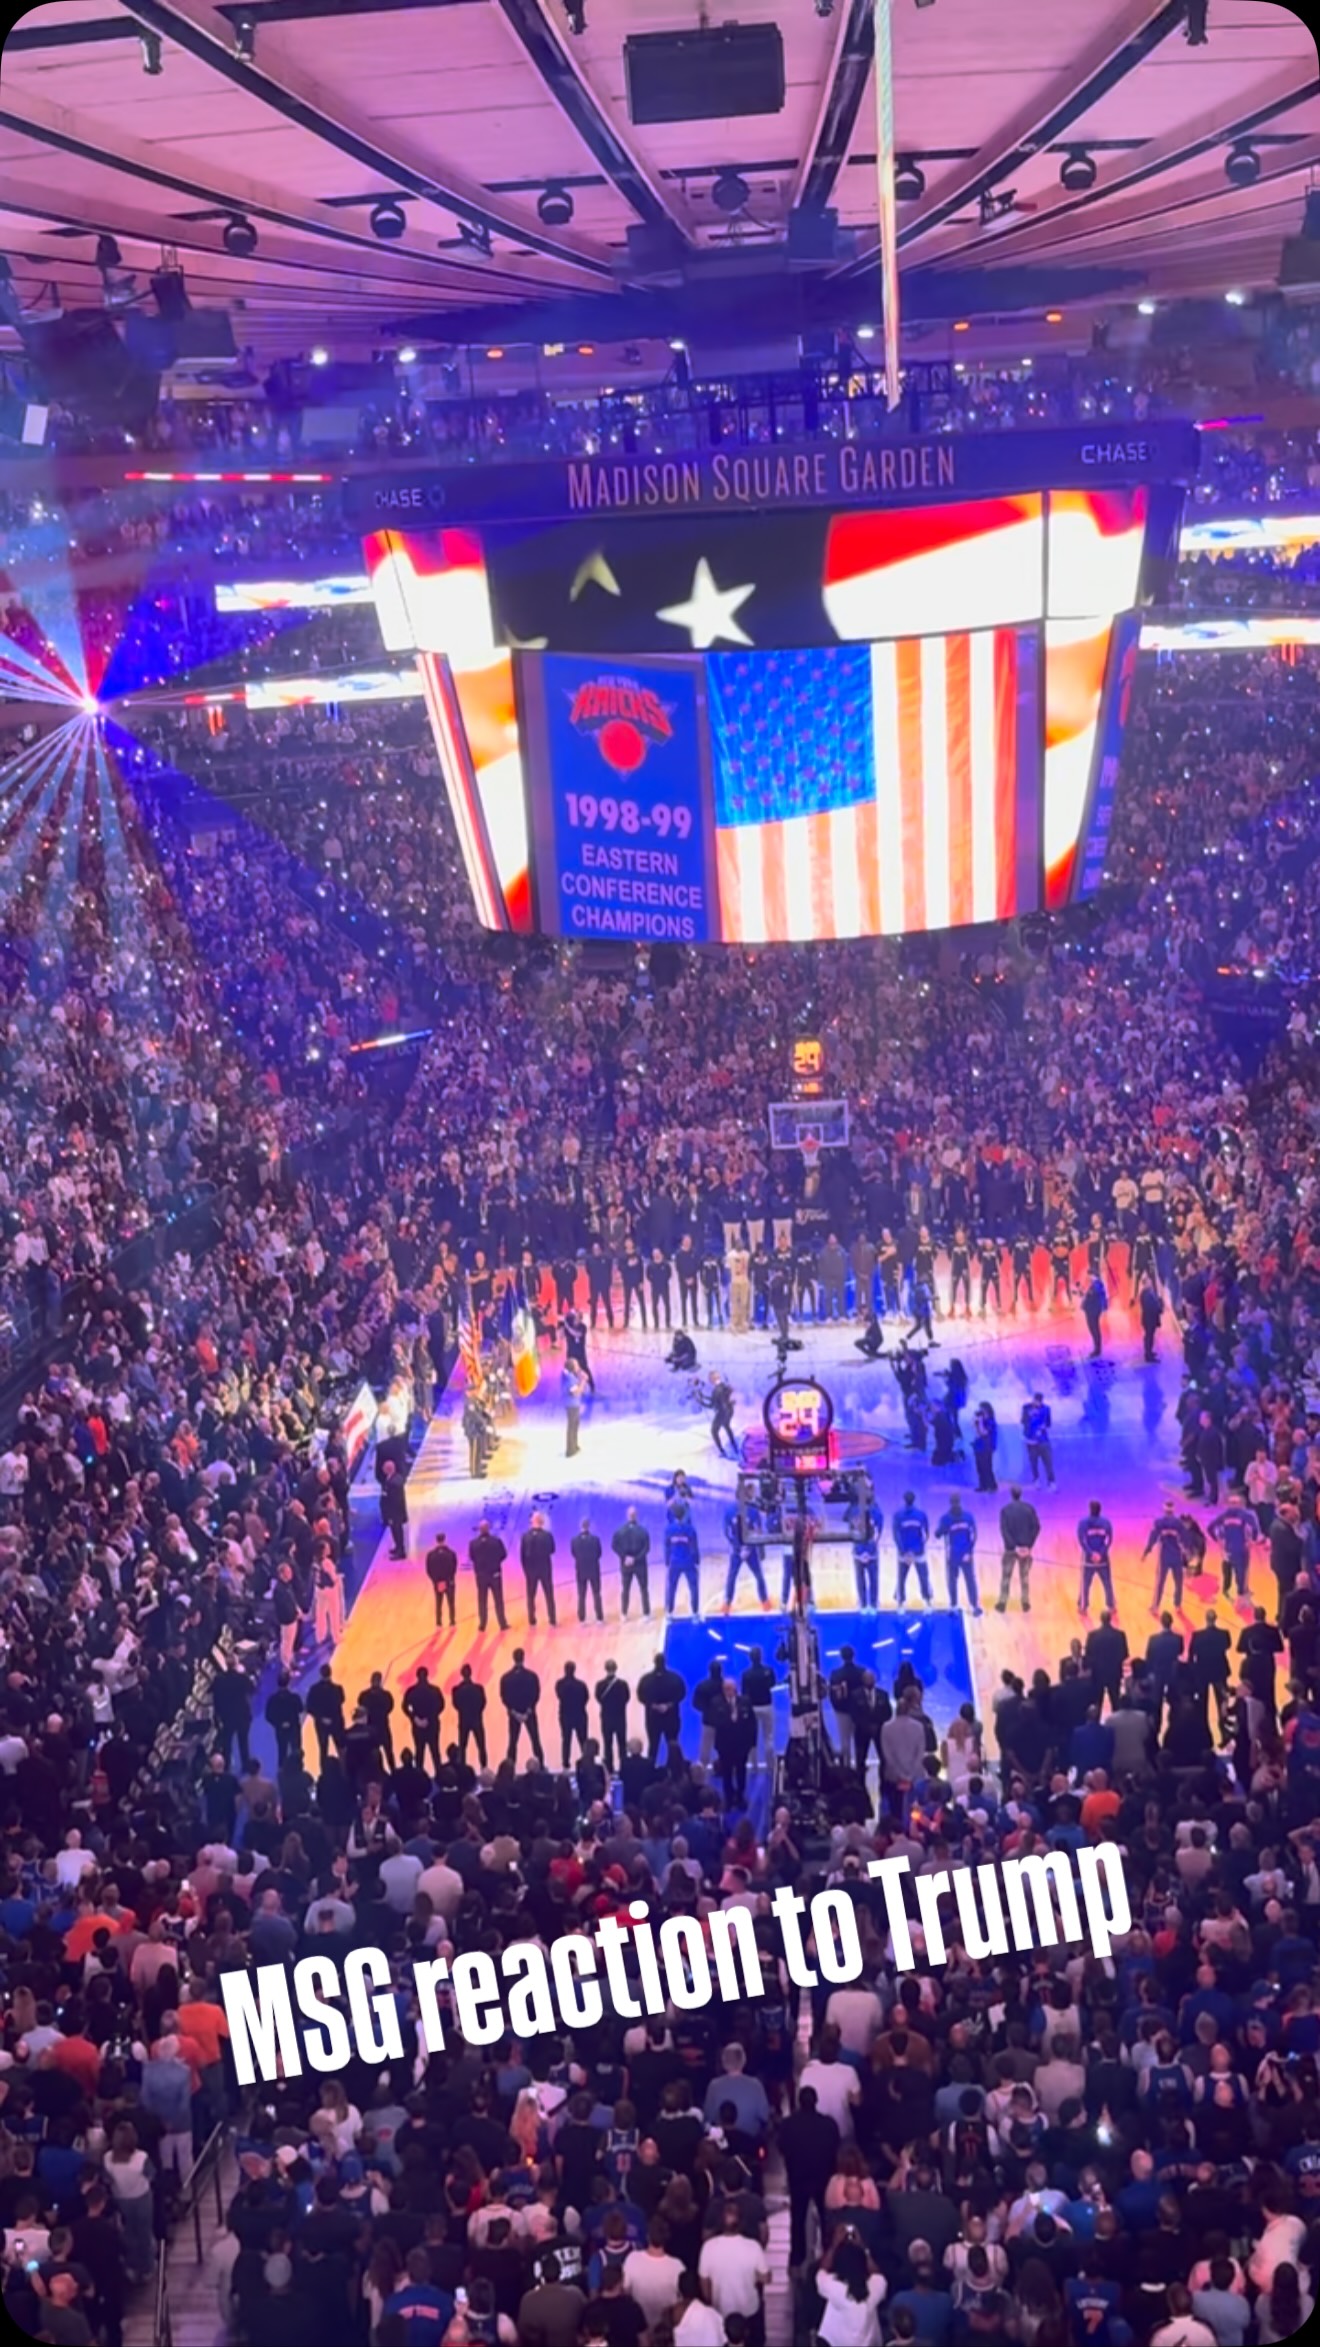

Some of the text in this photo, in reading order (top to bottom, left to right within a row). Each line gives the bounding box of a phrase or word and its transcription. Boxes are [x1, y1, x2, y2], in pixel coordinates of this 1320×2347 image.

[1081, 441, 1147, 464] CHASE
[565, 793, 692, 839] 1998-99
[581, 843, 679, 877] EASTERN
[561, 871, 704, 909] CONFERENCE
[571, 903, 696, 939] CHAMPIONS
